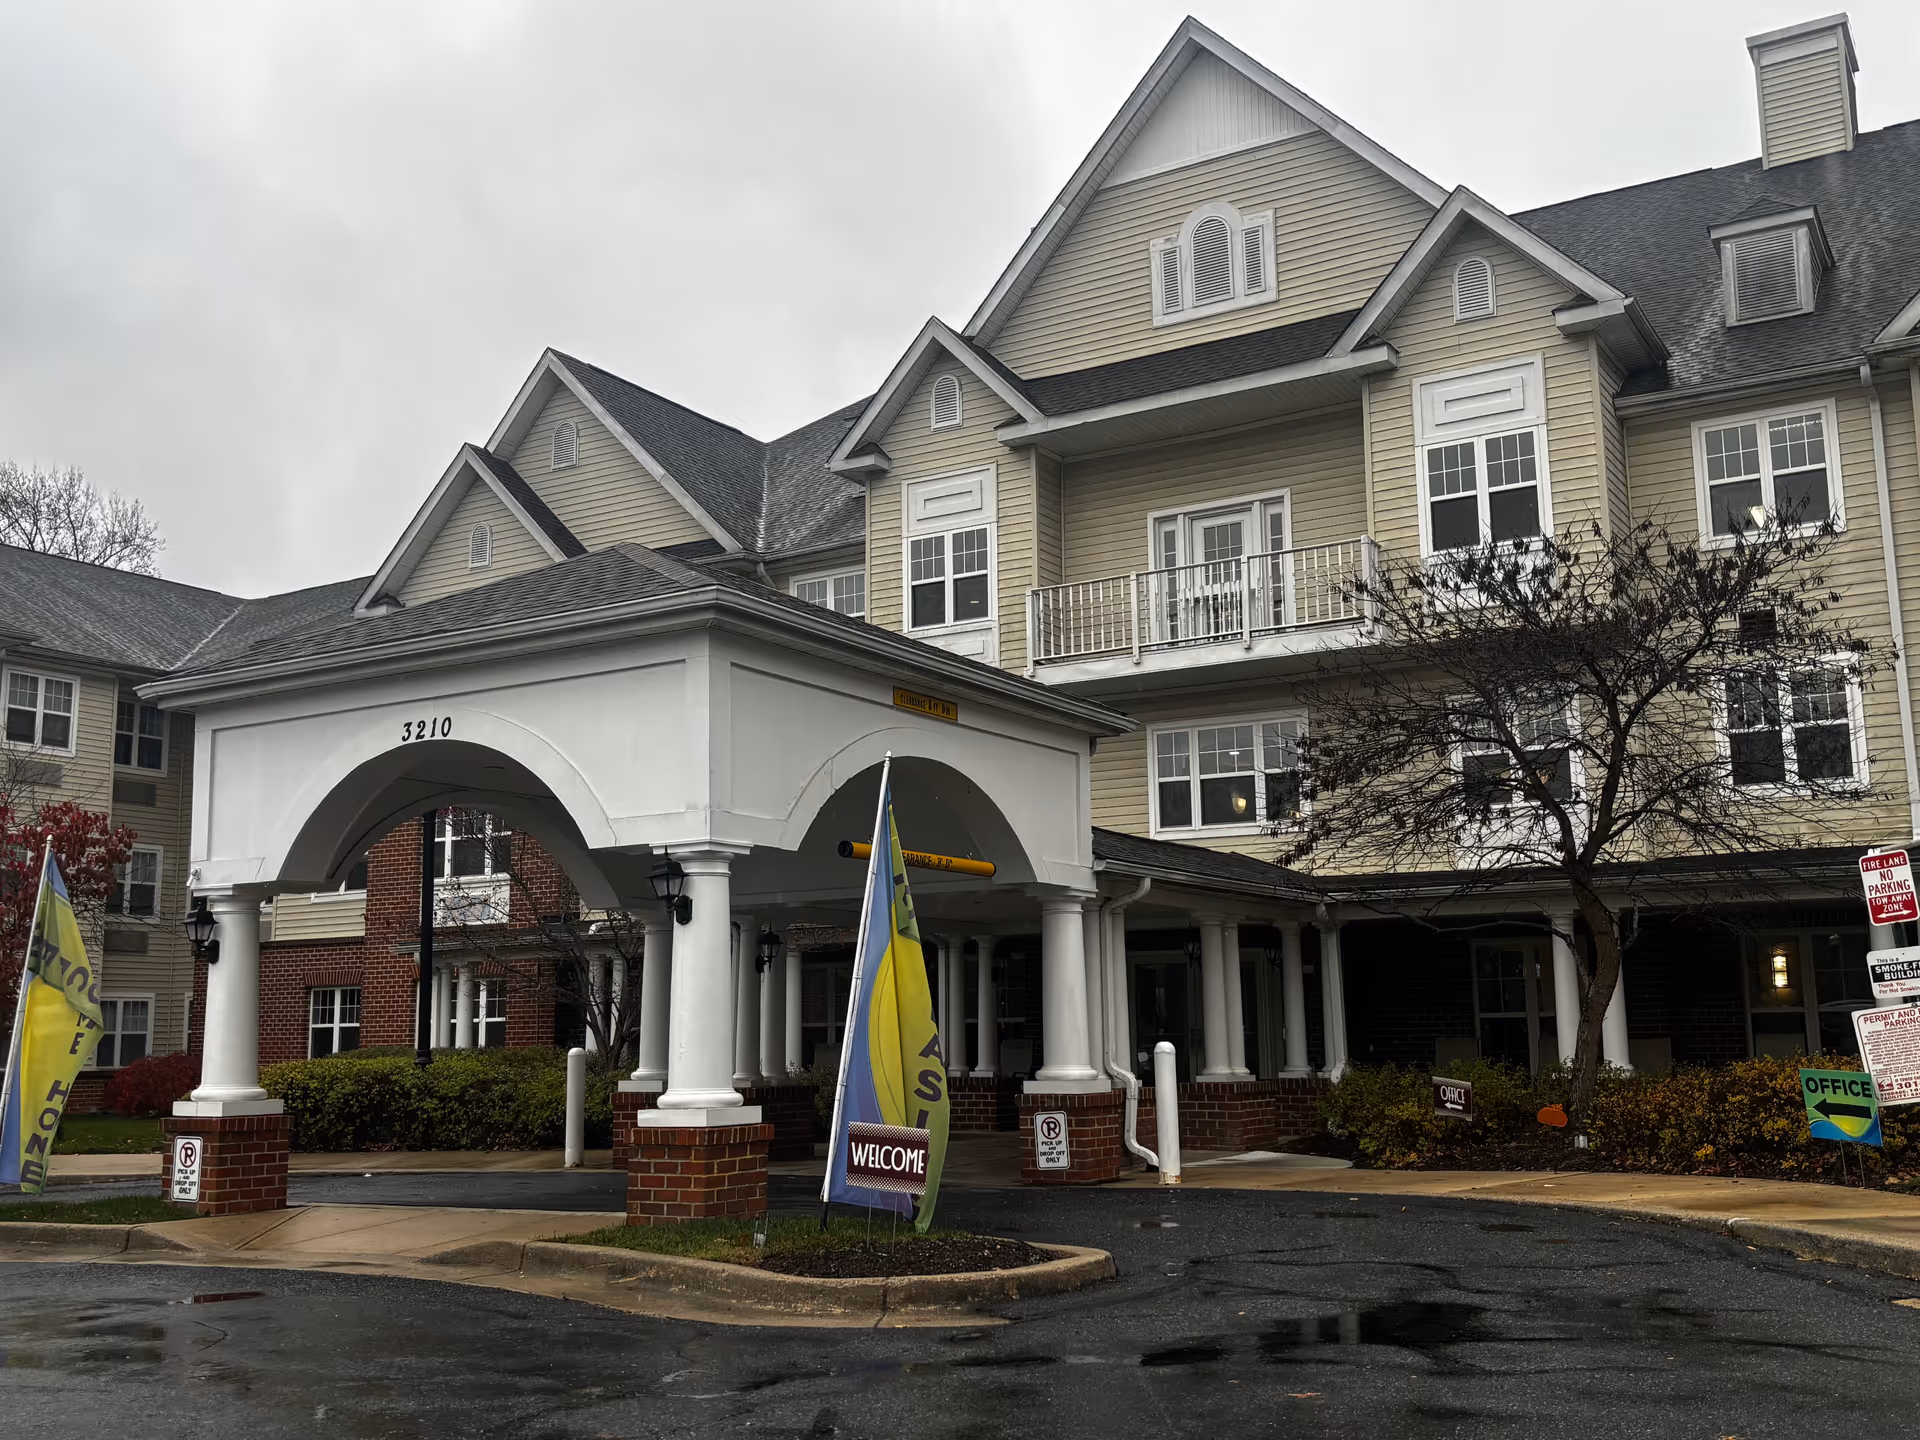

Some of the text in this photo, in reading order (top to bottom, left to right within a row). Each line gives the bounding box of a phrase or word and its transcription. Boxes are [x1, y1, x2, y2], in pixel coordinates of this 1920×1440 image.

[402, 717, 452, 742] 3210
[901, 851, 932, 866] EARANCE
[1863, 856, 1905, 870] FIRE LANE
[1879, 869, 1893, 882] NO
[1868, 879, 1910, 896] PARKING
[1871, 893, 1912, 906] TOW-AWAY
[1883, 903, 1904, 913] ZONE
[1863, 1012, 1895, 1024] PERMIT
[1897, 1009, 1916, 1019] AND
[1884, 1015, 1920, 1028] PARKING
[1805, 1076, 1873, 1099] OFFICE
[1896, 1081, 1920, 1090] 301
[1440, 1085, 1465, 1104] OFFICE
[851, 1141, 926, 1174] WELCOME
